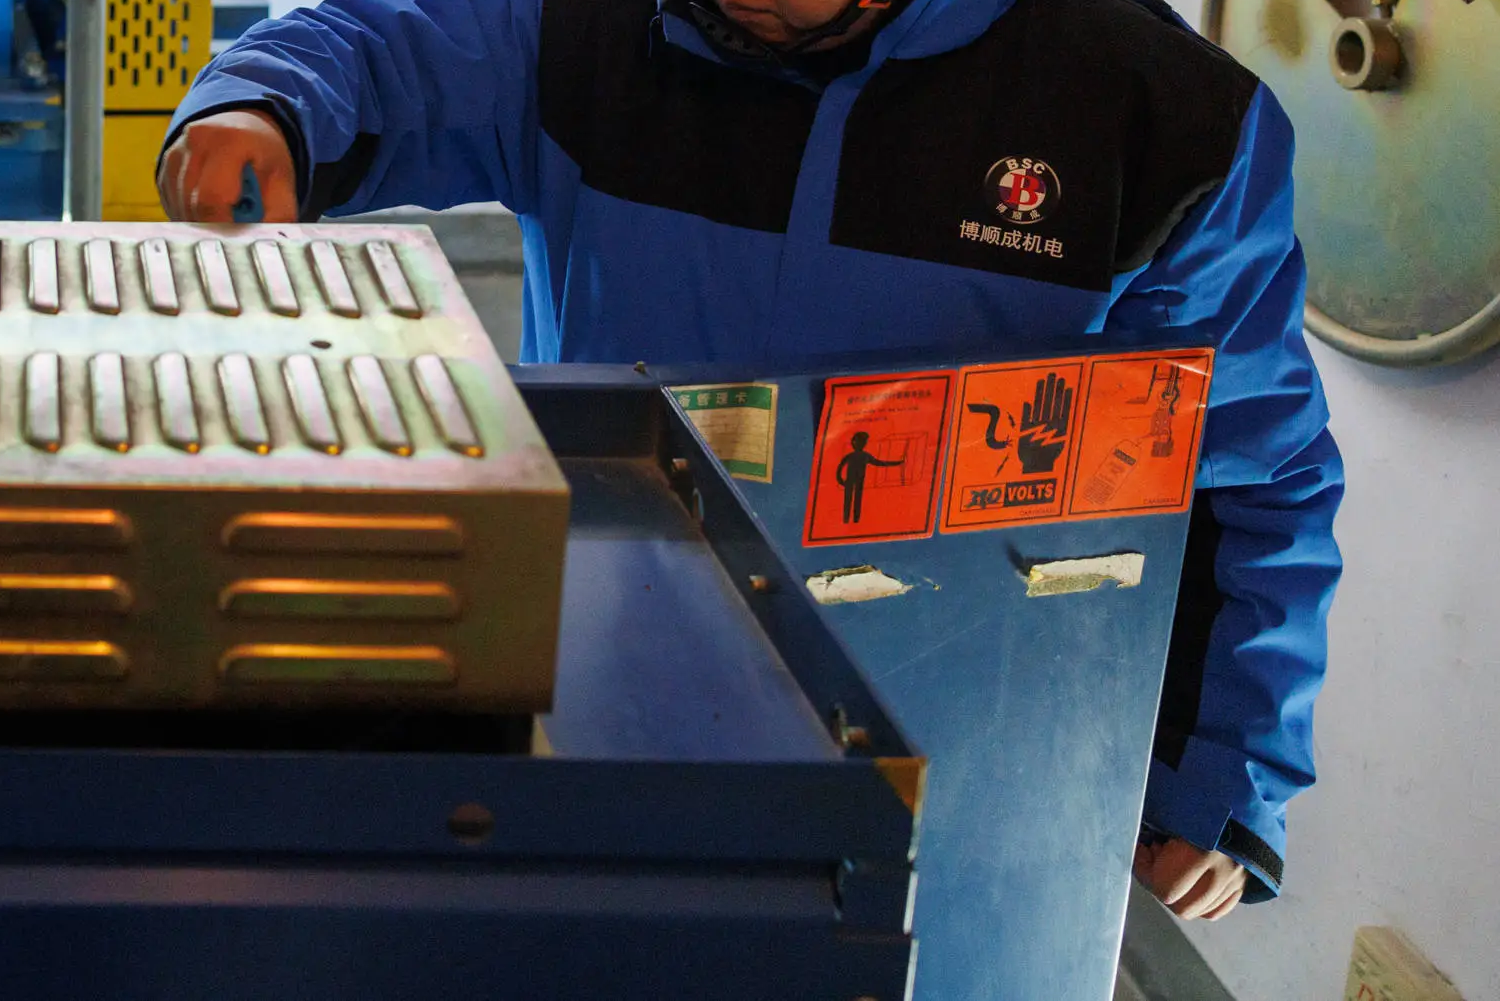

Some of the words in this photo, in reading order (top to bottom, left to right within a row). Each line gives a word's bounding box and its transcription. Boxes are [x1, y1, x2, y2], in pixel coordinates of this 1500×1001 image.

[1005, 157, 1045, 174] BSC
[959, 219, 1064, 259] 博顺成机电
[1007, 483, 1054, 502] VOLTS
